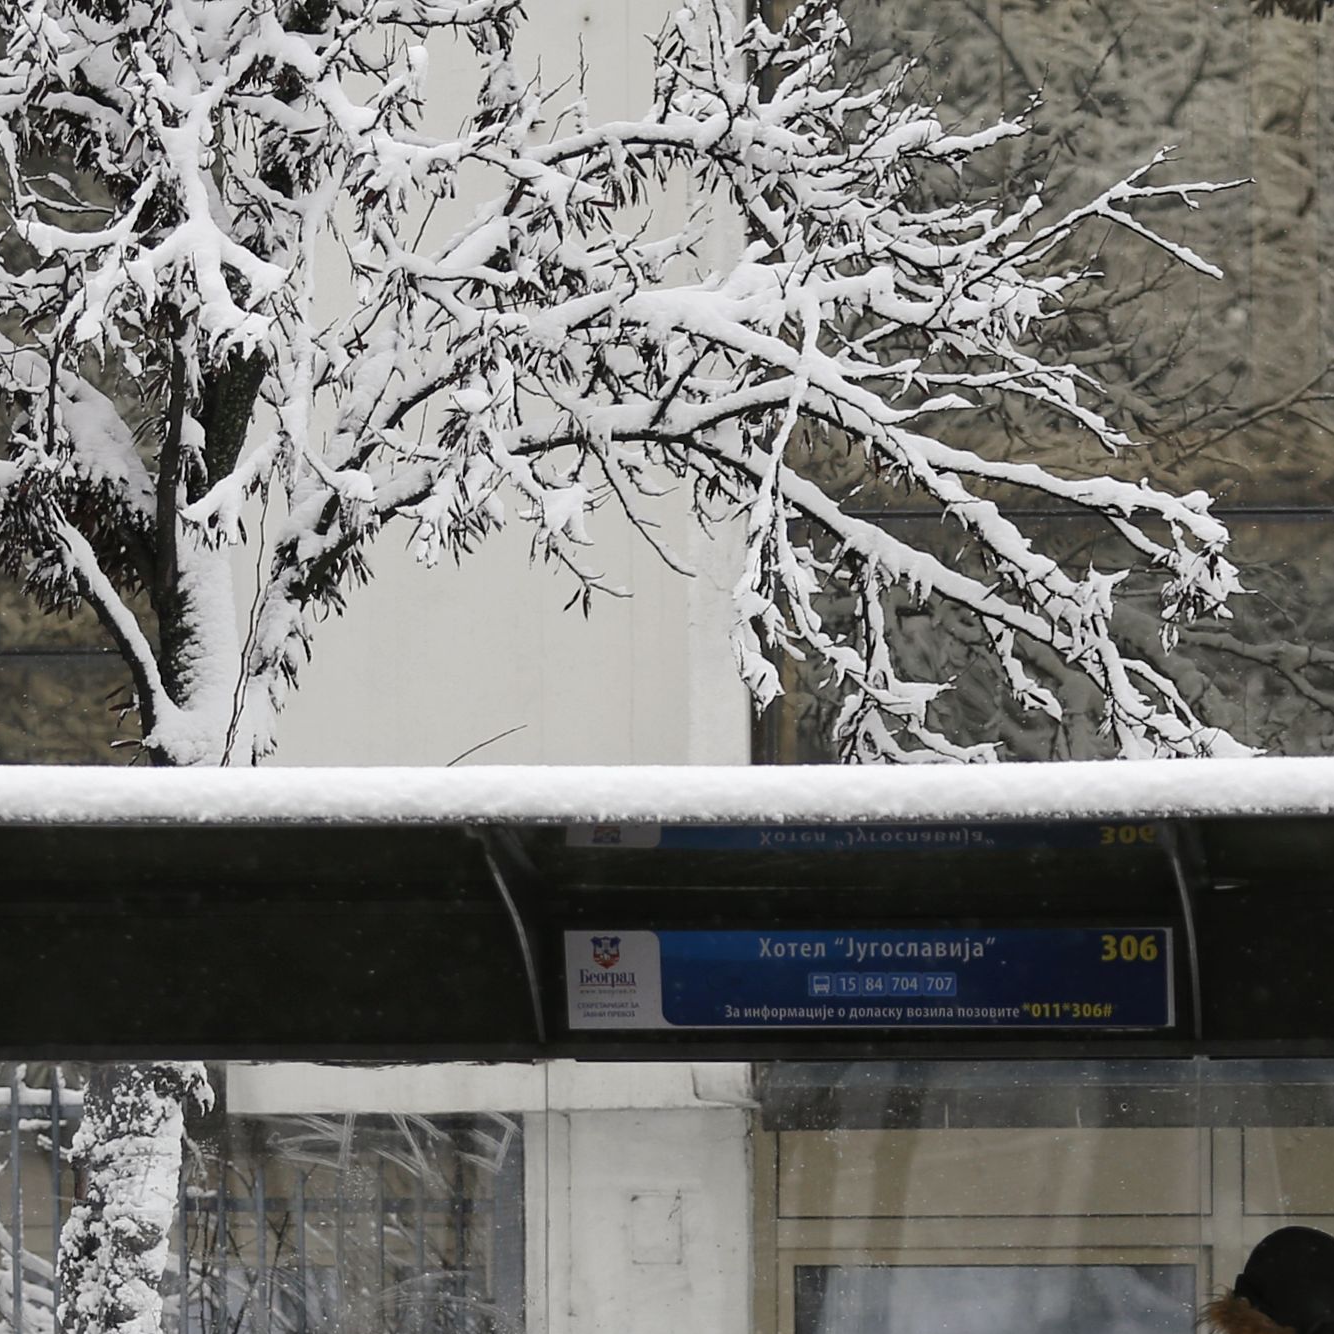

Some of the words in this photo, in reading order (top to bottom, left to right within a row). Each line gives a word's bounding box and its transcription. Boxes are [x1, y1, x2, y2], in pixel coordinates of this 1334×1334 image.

[759, 937, 826, 958] Хотел
[1101, 935, 1158, 961] 306
[579, 969, 636, 988] Београд
[839, 977, 857, 992] 15
[865, 977, 884, 992] 84
[891, 977, 919, 992] 704
[926, 977, 953, 992] 707
[724, 1004, 741, 1018] За
[744, 1004, 835, 1021] информације
[838, 1007, 846, 1018] о
[849, 1006, 903, 1021] доласку
[906, 1006, 954, 1018] возила
[957, 1006, 1020, 1018] позовите
